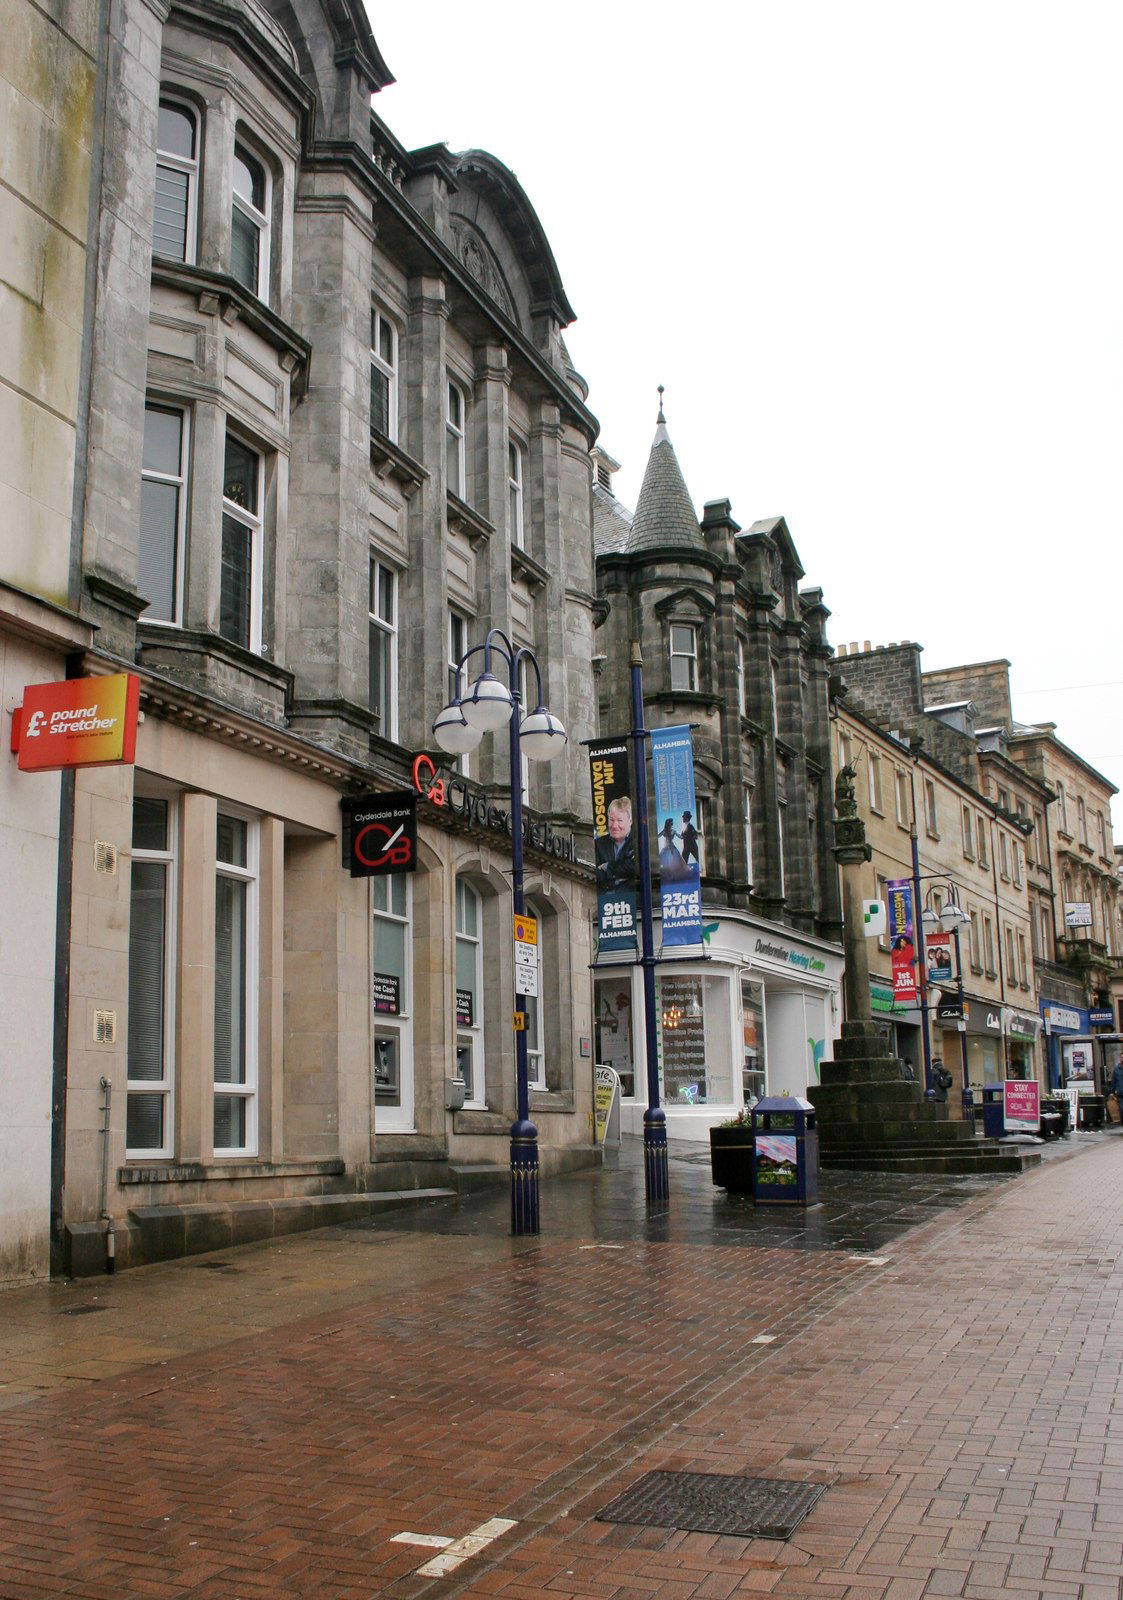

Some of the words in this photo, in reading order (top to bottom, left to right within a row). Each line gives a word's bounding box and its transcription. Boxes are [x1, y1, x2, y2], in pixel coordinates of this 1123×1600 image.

[50, 704, 98, 724] pound
[49, 717, 117, 734] stretcher
[589, 746, 627, 757] ALHAMBRA
[653, 739, 690, 750] ALHAMBRA
[603, 760, 615, 785] JIM
[592, 760, 607, 837] DAVIDSON
[354, 812, 393, 822] Clydesdale
[393, 808, 411, 817] Bank
[662, 891, 699, 907] 23rd
[603, 901, 631, 916] 9th
[663, 904, 700, 919] MAR
[894, 892, 907, 934] MOTOWN
[602, 914, 633, 929] FEB
[663, 920, 701, 928] ALHAMBRA
[599, 930, 637, 939] ALHAMBRA
[895, 978, 914, 987] JUN
[896, 971, 910, 980] 1st
[382, 984, 396, 995] Cash
[458, 999, 470, 1008] Cash
[1014, 1083, 1029, 1092] STAY
